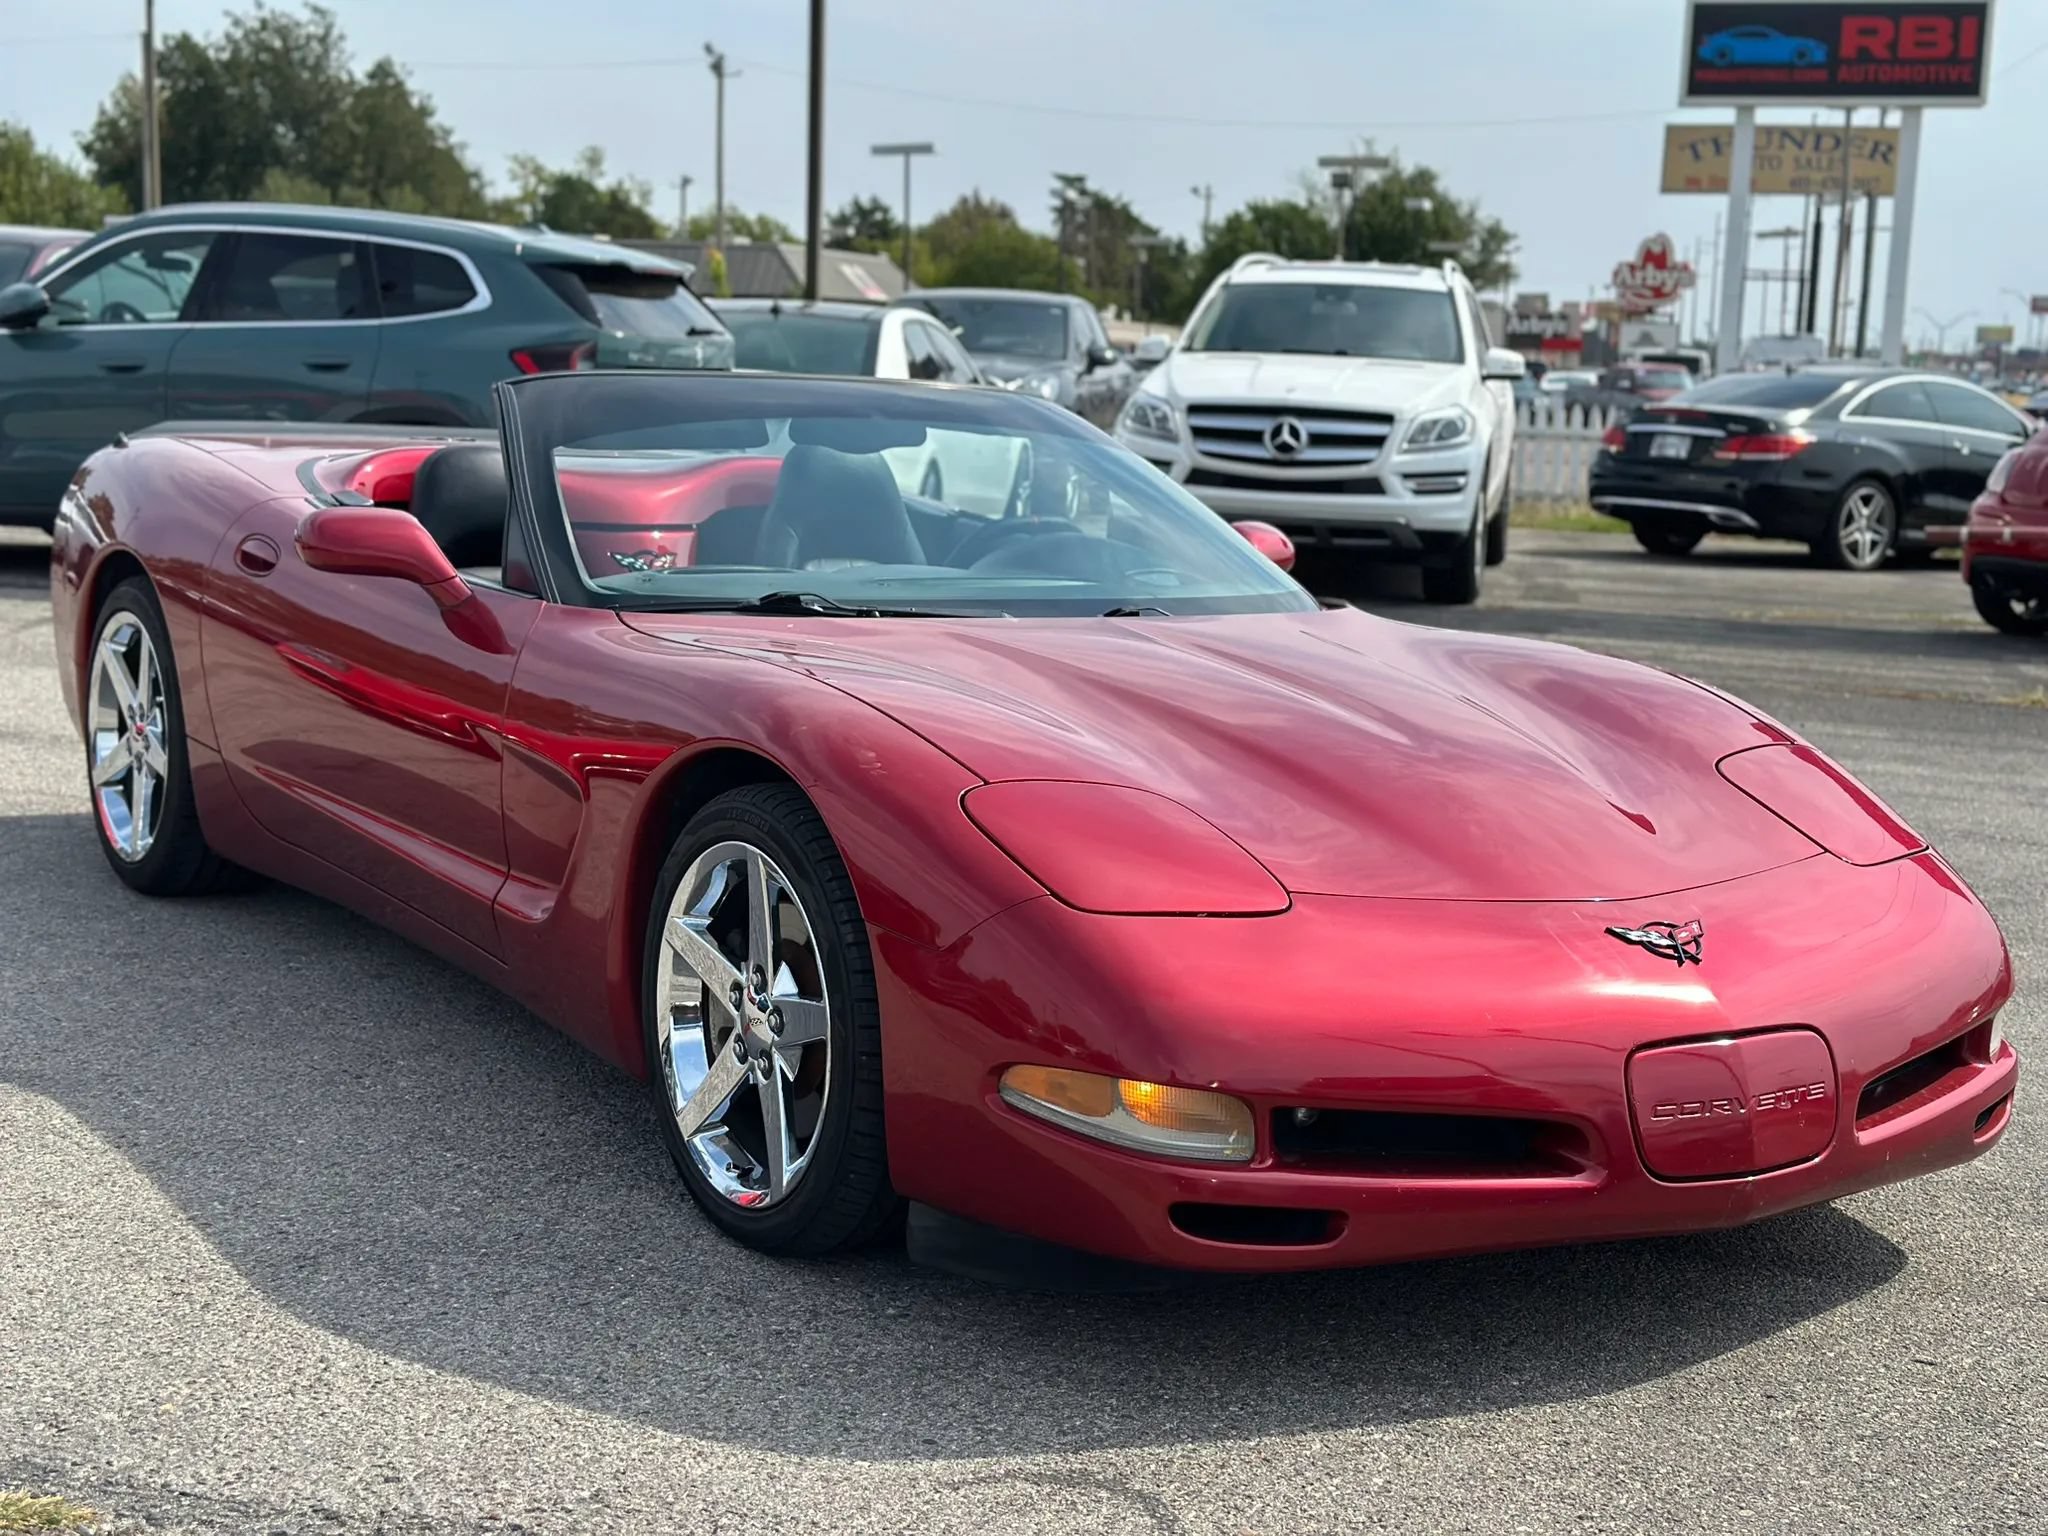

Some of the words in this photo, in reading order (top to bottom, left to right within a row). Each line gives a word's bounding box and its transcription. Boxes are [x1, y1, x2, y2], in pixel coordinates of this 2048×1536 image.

[1838, 16, 1980, 60] RBI
[1837, 63, 1975, 84] AUTOMOTIVE
[1651, 1081, 1825, 1121] CORVETTE
